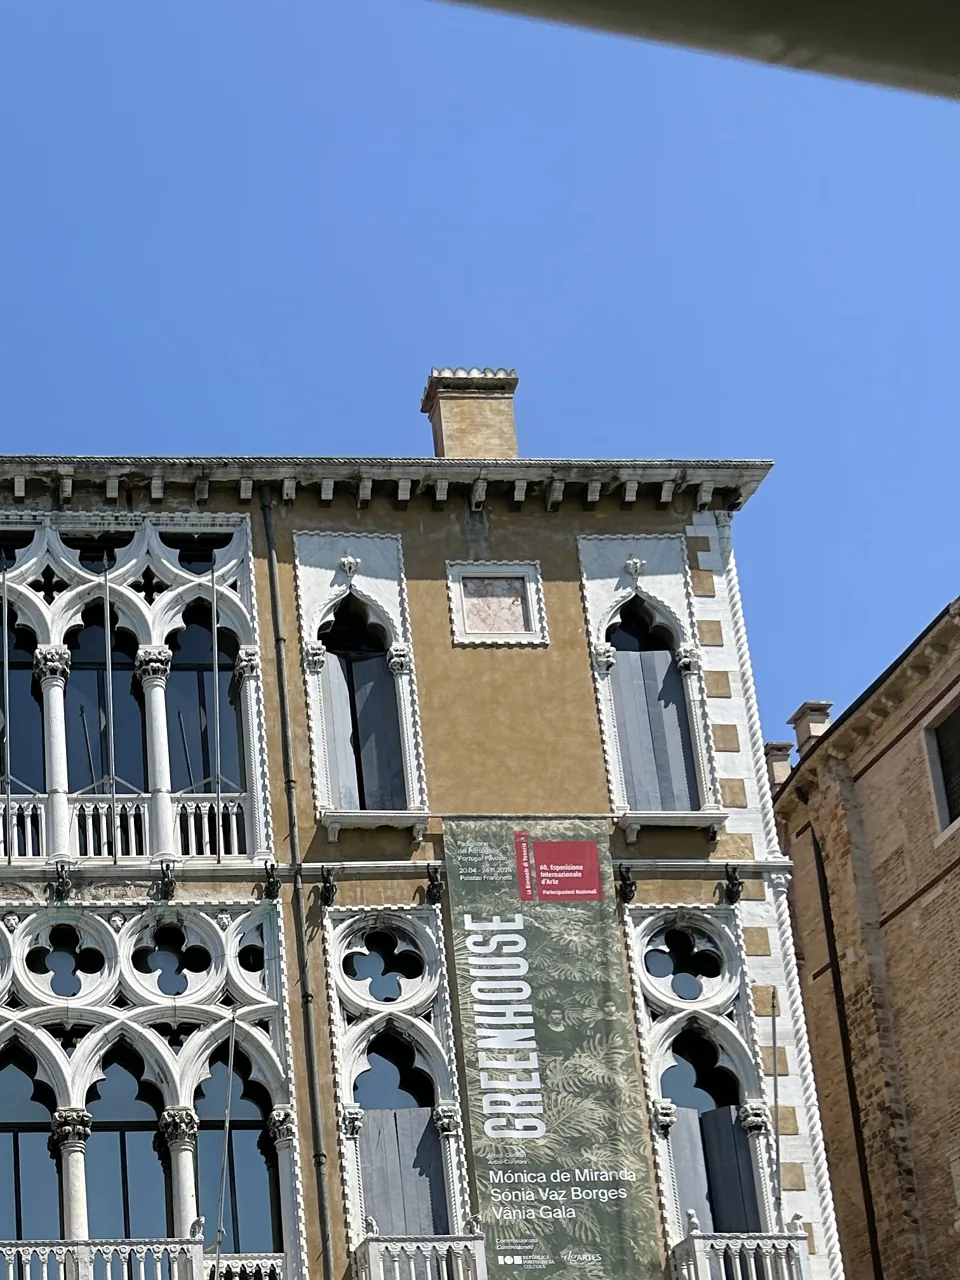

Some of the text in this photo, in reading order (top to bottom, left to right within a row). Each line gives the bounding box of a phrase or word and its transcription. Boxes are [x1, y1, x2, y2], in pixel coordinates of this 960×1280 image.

[464, 913, 547, 1139] GREENHOUSE
[489, 1168, 636, 1183] Mónica de Miranda
[490, 1186, 627, 1203] Sónia Vaz Borges
[492, 1205, 576, 1220] Vânia Gala
